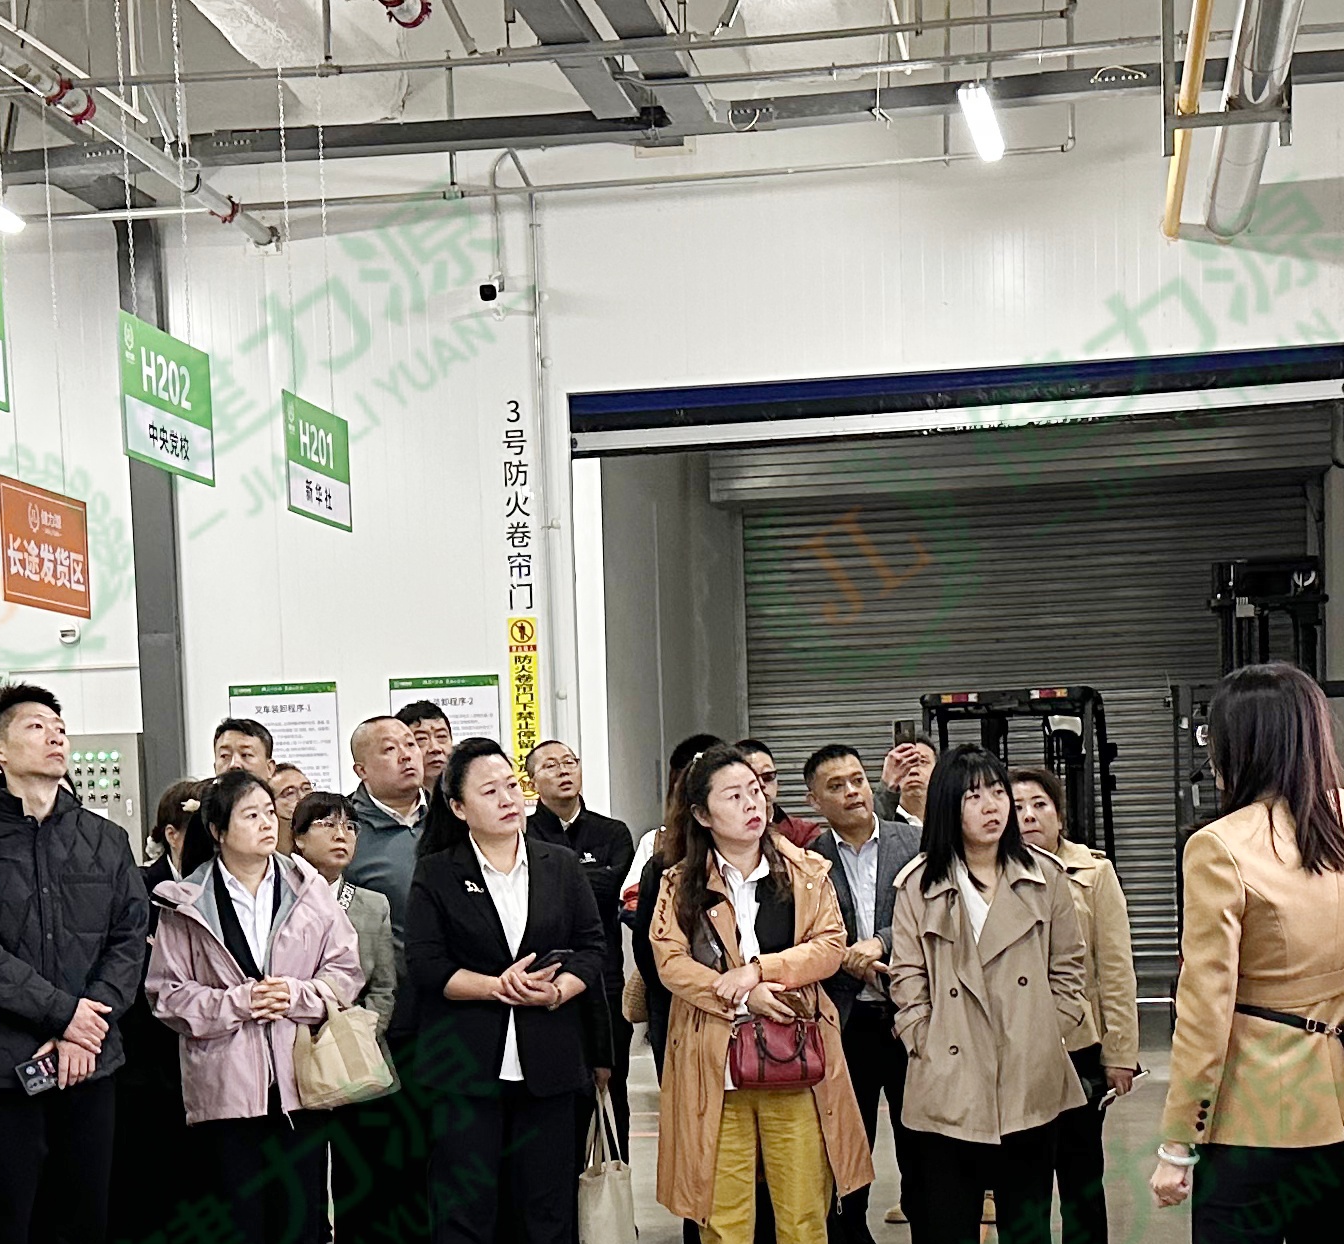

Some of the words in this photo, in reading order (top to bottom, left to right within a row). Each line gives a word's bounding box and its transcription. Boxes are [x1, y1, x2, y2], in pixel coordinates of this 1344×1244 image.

[140, 346, 192, 411] H202
[299, 419, 334, 470] H201
[502, 399, 533, 611] 3号防火卷帘门
[7, 533, 86, 592] 长途发货区
